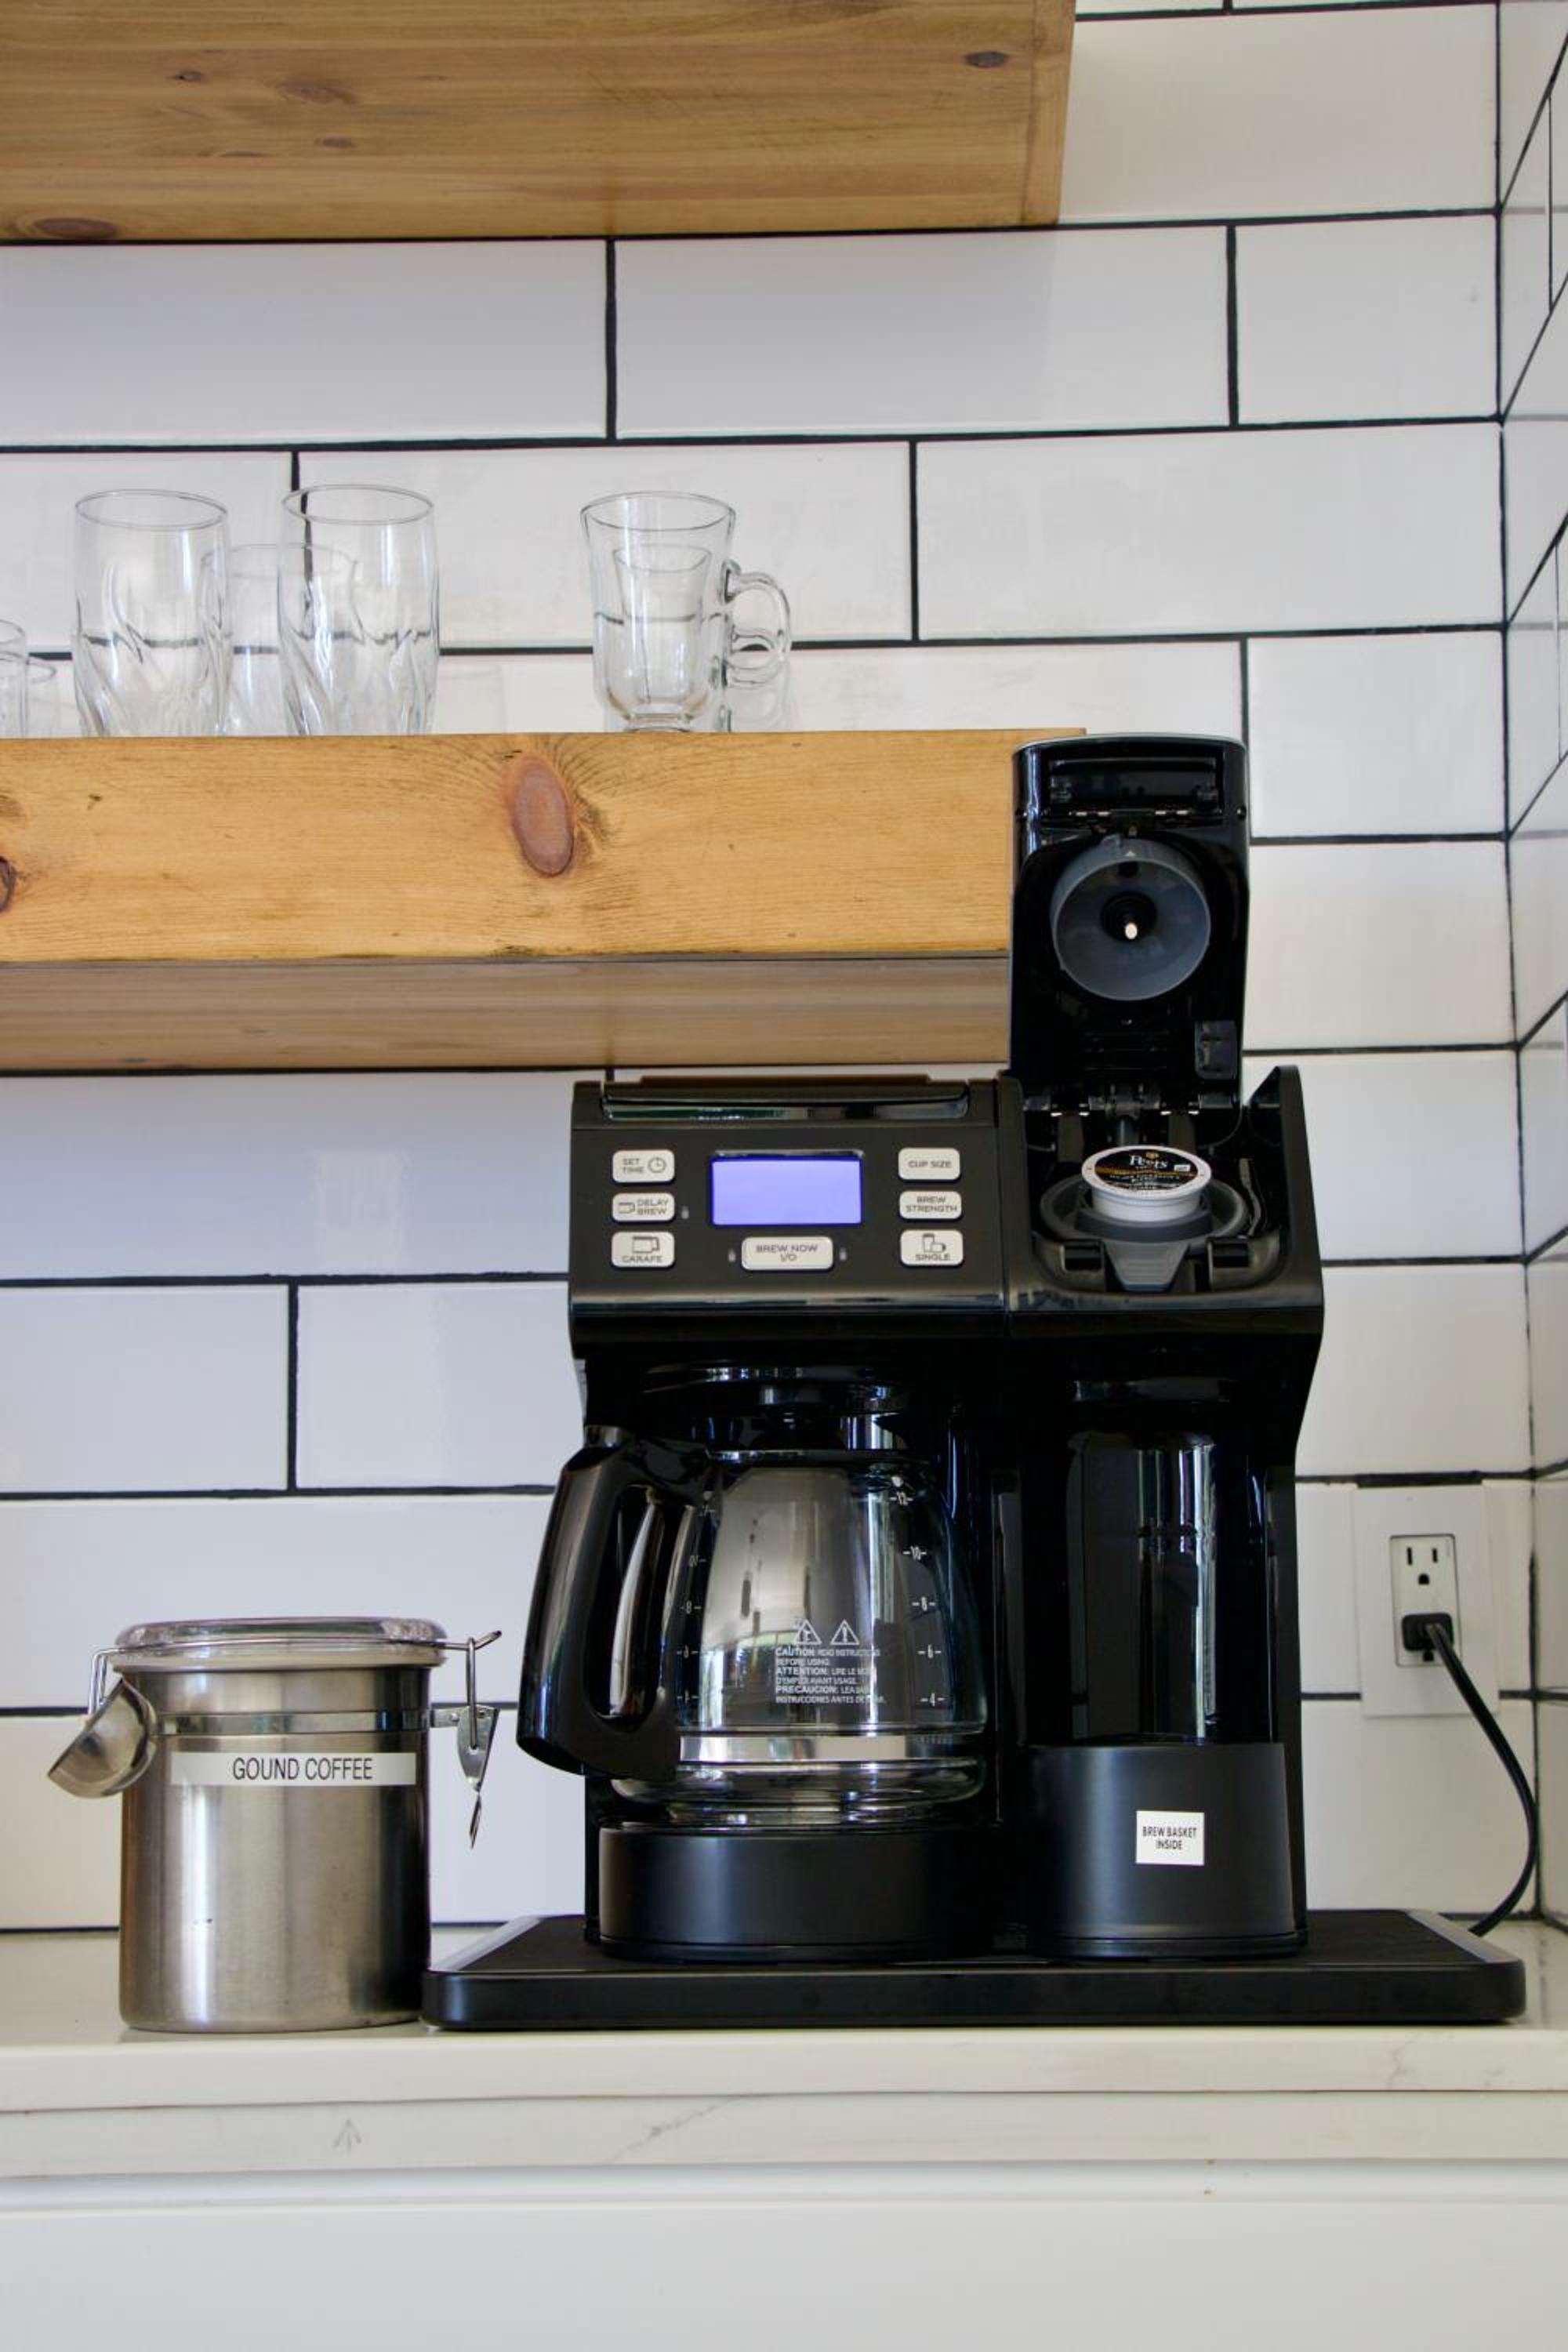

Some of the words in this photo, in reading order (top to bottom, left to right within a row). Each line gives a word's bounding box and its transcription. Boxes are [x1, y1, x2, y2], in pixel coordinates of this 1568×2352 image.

[906, 1204, 957, 1213] STRENGTH
[756, 1244, 788, 1253] BREW
[791, 1244, 818, 1253] NOW
[622, 1254, 663, 1263] CARAFE
[779, 1254, 797, 1262] I/O
[915, 1253, 950, 1261] SINGLE
[232, 1756, 300, 1780] GOUND
[305, 1757, 373, 1780] COFFEE
[1142, 1826, 1165, 1837] BREW
[1166, 1827, 1197, 1838] BASKET
[1156, 1839, 1182, 1850] INSIDE
